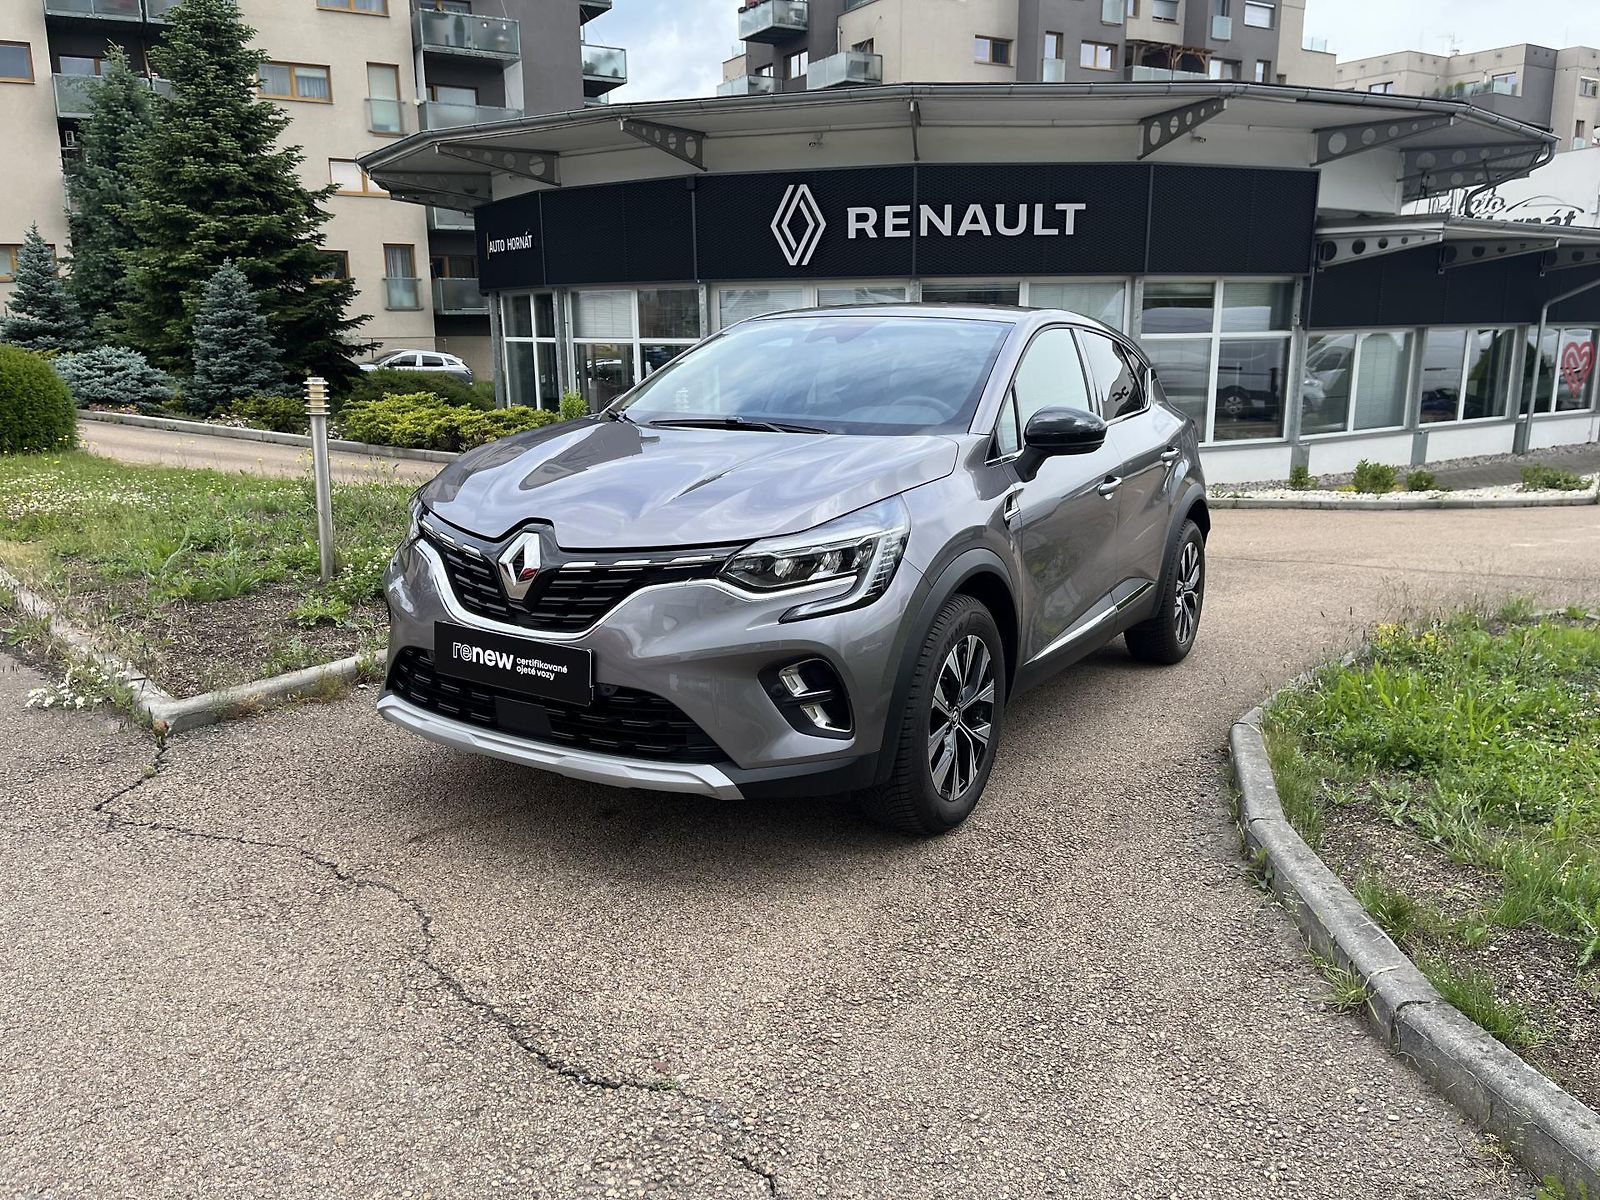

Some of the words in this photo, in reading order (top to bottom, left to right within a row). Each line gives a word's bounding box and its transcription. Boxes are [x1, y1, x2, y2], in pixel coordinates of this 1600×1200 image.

[846, 203, 1087, 239] RENAULT
[489, 239, 505, 253] AUTO
[506, 230, 533, 251] HORNÁT
[452, 641, 514, 670] renew
[516, 657, 568, 674] certifikované
[516, 665, 536, 676] ojeté
[536, 669, 555, 681] vozy
